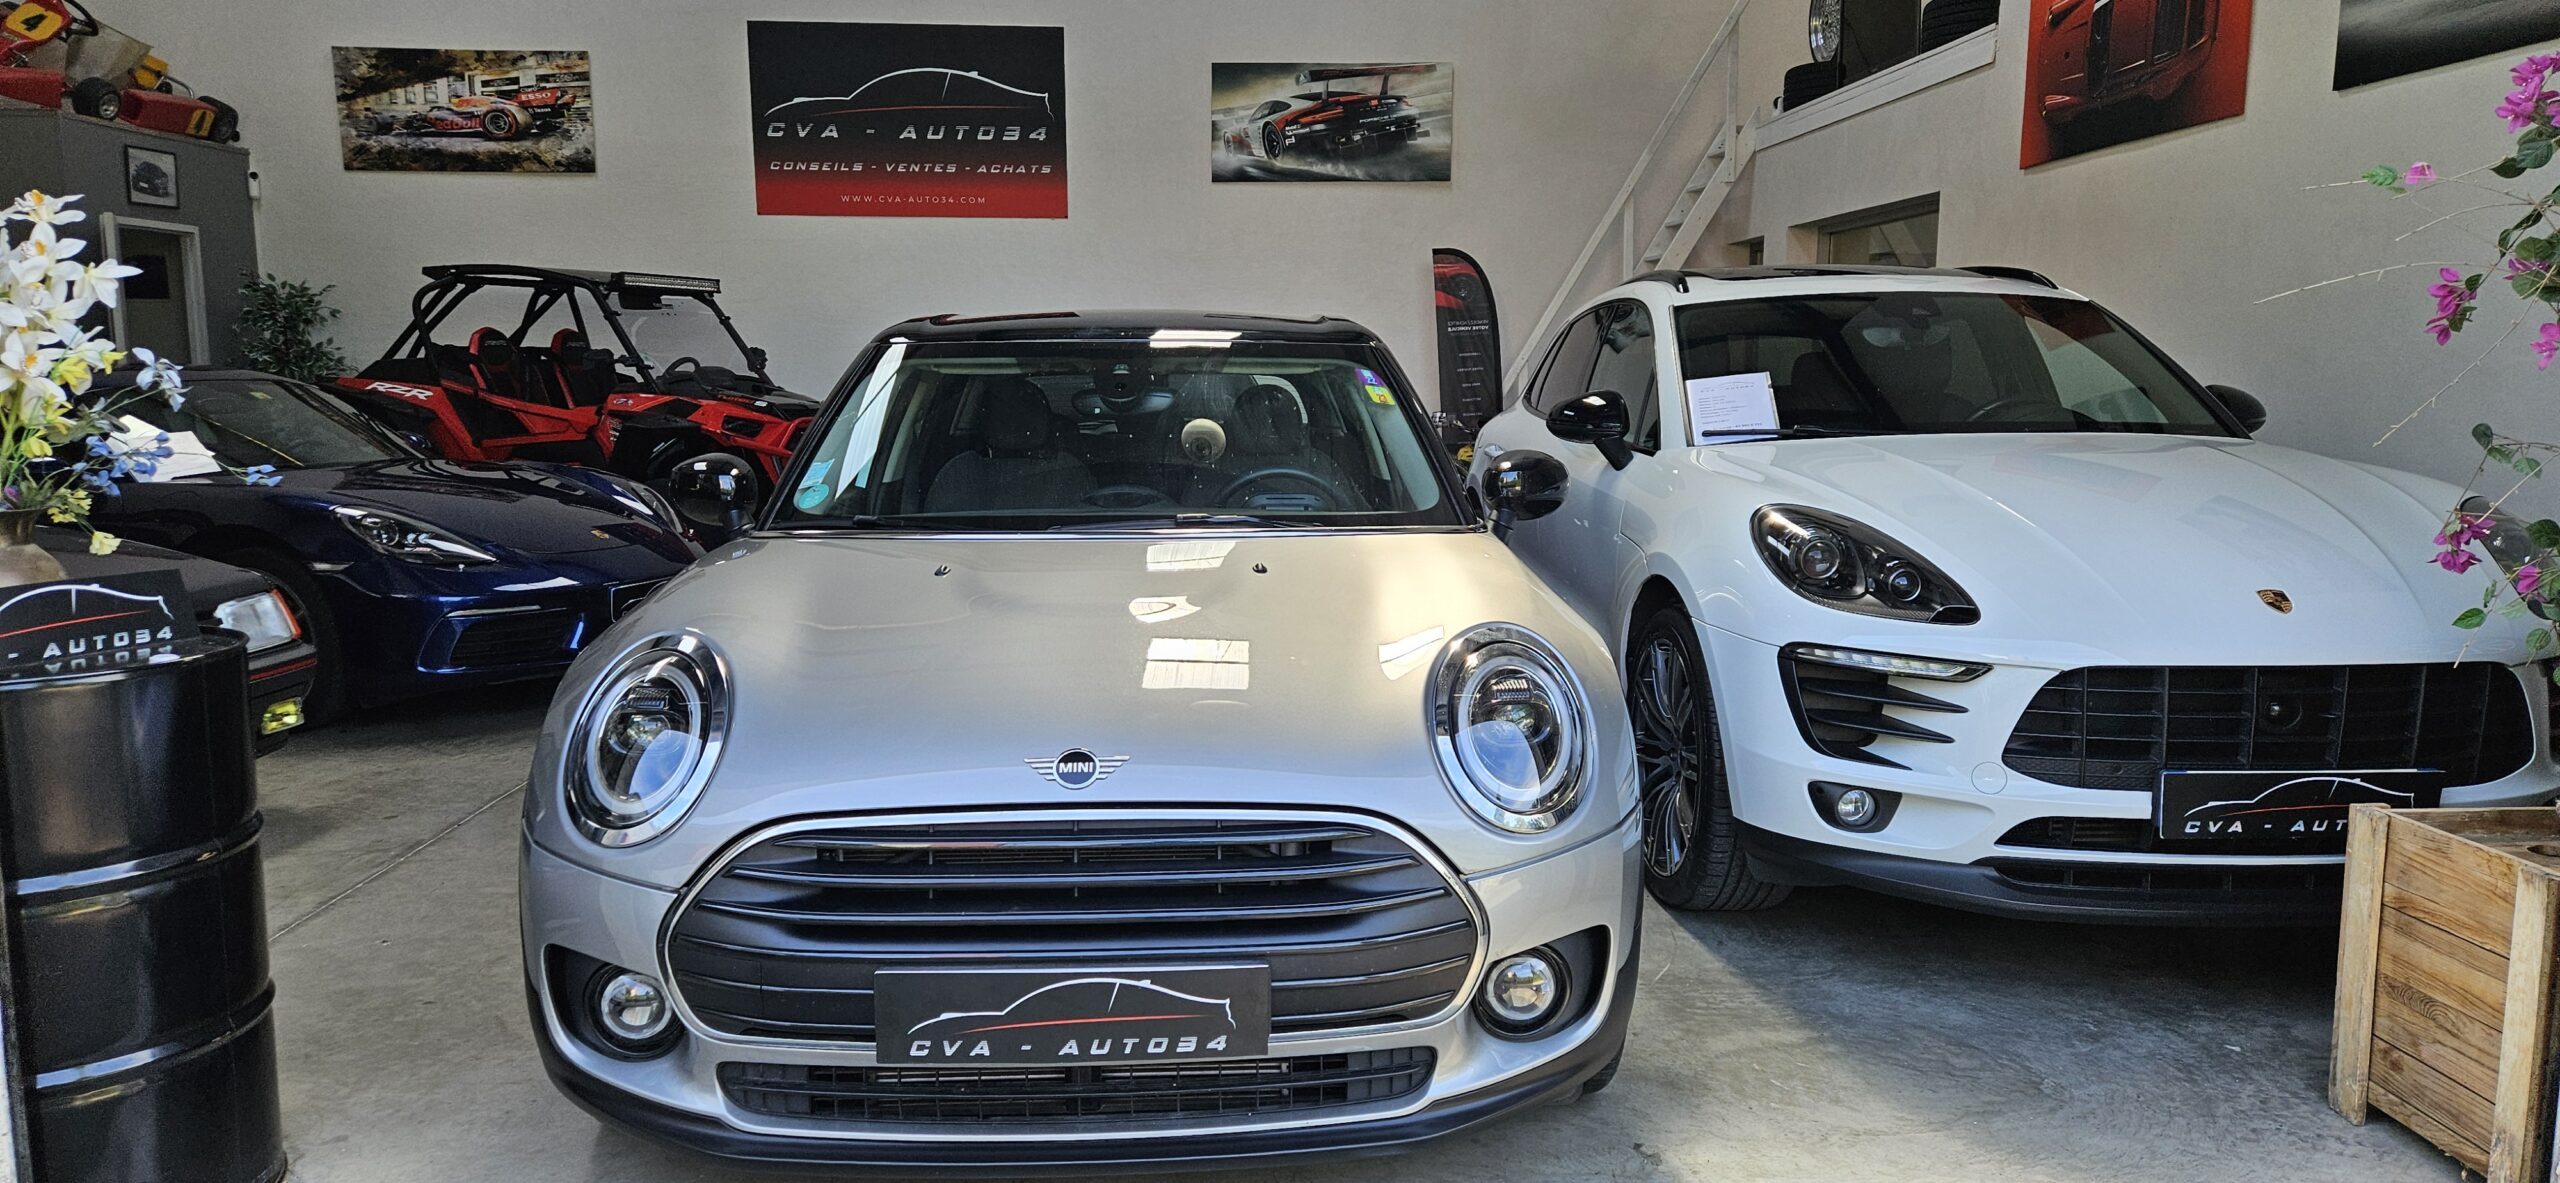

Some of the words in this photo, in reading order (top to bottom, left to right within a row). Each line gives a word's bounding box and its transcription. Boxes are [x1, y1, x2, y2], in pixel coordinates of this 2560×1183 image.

[21, 13, 48, 32] 4
[521, 92, 551, 101] ESSO
[766, 122, 839, 138] CVA
[899, 124, 1048, 141] AUTO34
[769, 161, 864, 172] CONSEILS
[885, 163, 957, 173] VENTES
[977, 164, 1053, 174] ACHATS
[840, 194, 986, 205] WWW.CVA-AUTO34.COM
[365, 381, 434, 401] RZR
[42, 625, 173, 659] AUTO34
[1058, 761, 1094, 774] MINI
[2184, 820, 2244, 833] CVA
[2290, 819, 2348, 832] AUT
[909, 1039, 992, 1057] CVA
[1058, 1035, 1228, 1056] AUTO34
